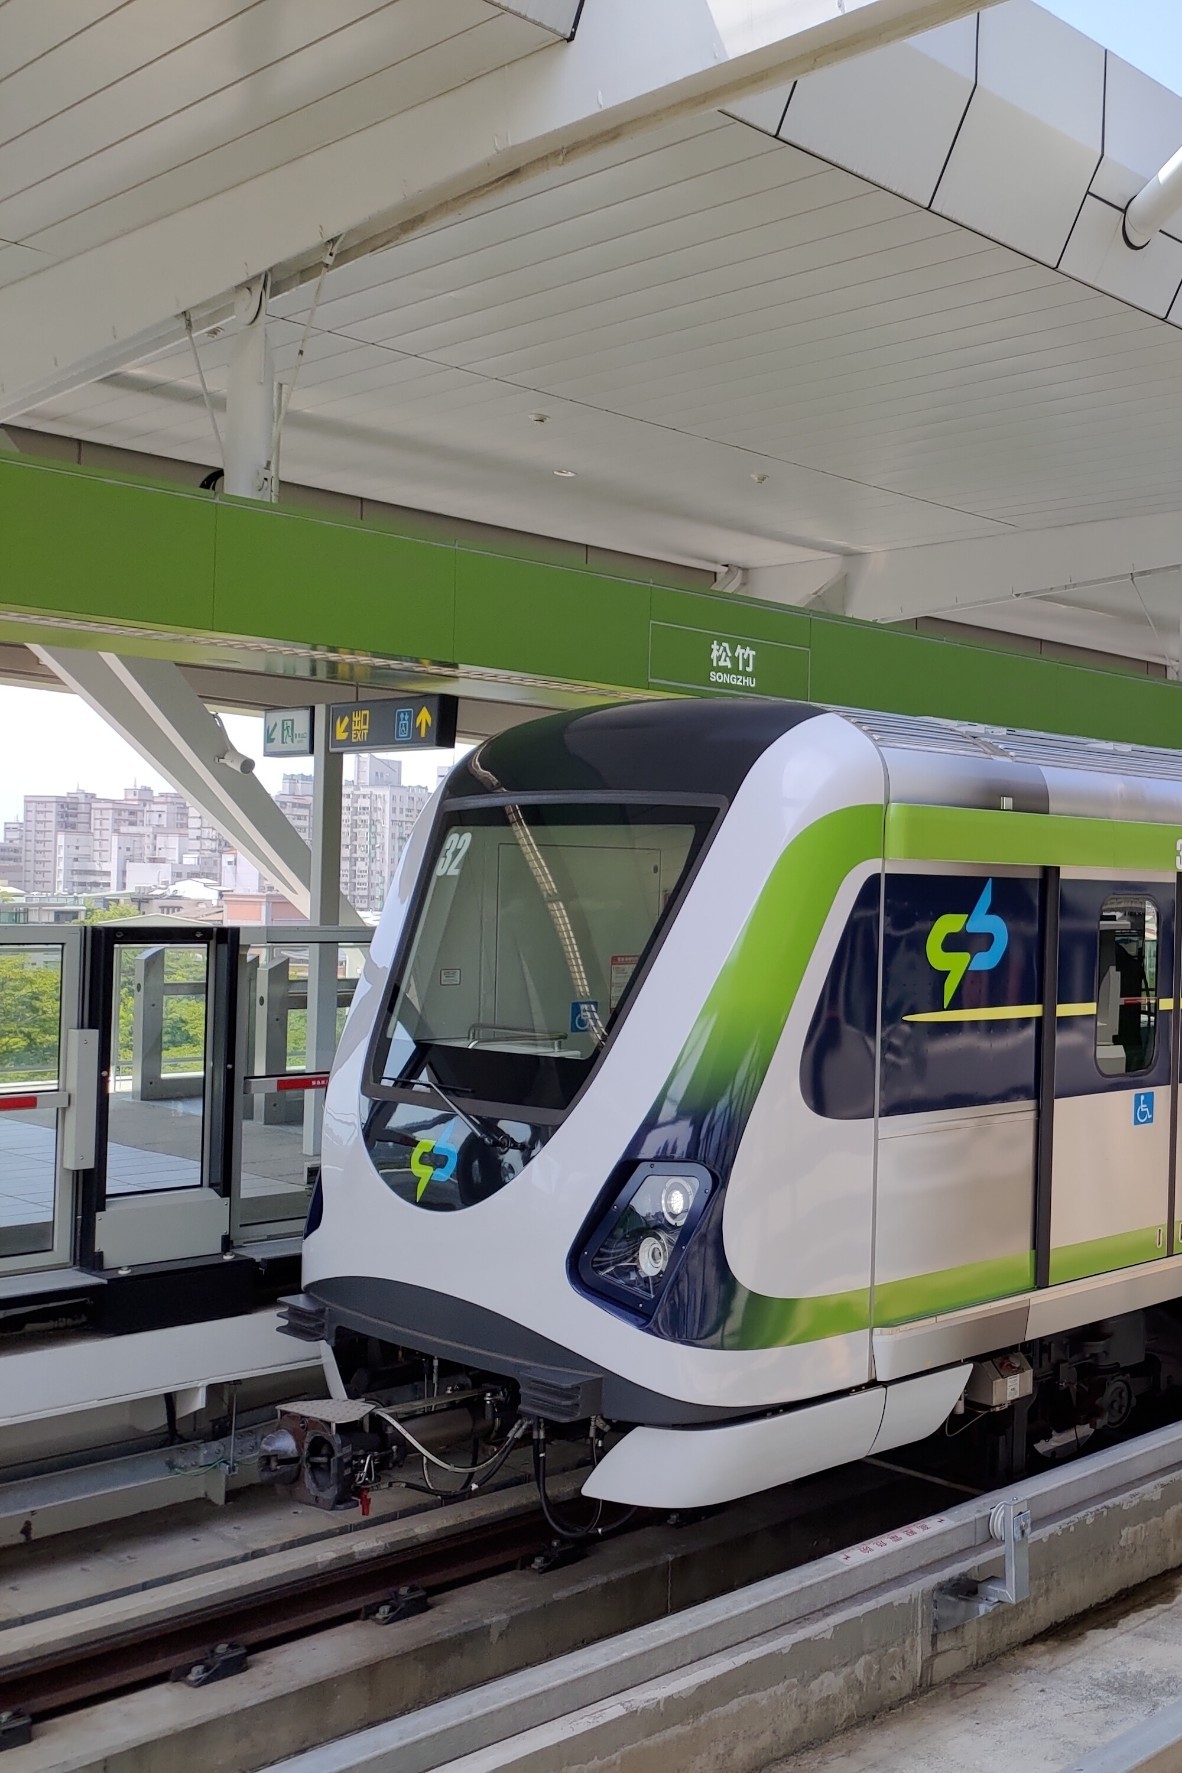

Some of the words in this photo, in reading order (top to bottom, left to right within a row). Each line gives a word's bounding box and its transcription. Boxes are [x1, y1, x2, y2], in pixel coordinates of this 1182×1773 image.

[711, 640, 756, 672] 松竹
[709, 671, 756, 687] SONGZHU
[352, 710, 370, 730] 出口
[352, 729, 369, 742] EXIT
[436, 832, 472, 876] 32
